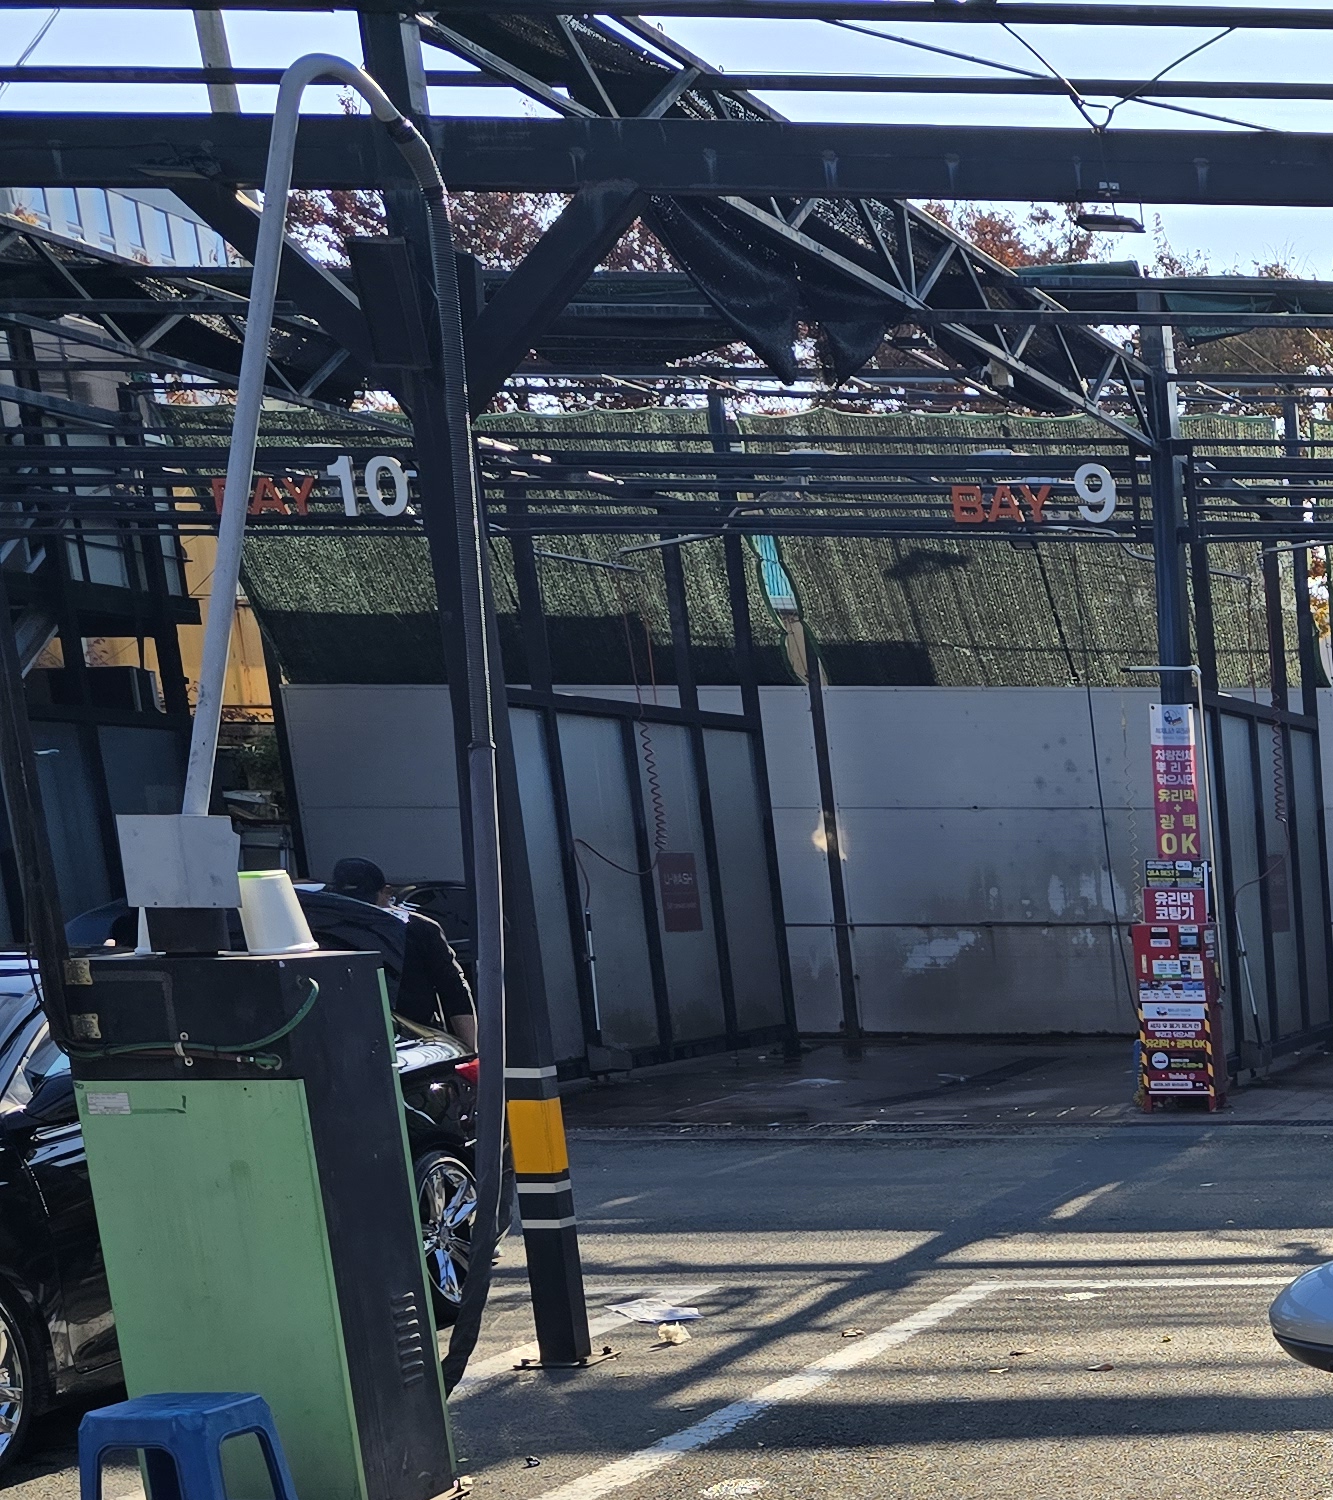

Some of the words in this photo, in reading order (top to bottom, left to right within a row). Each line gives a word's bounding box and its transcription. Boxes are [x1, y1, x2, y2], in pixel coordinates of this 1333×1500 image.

[327, 455, 409, 517] 10
[951, 485, 1051, 522] BAY
[1074, 463, 1117, 523] 9
[1157, 788, 1195, 802] 유리막
[1161, 833, 1198, 854] OK
[1154, 891, 1195, 906] 유리막
[1155, 906, 1195, 921] 코팅기
